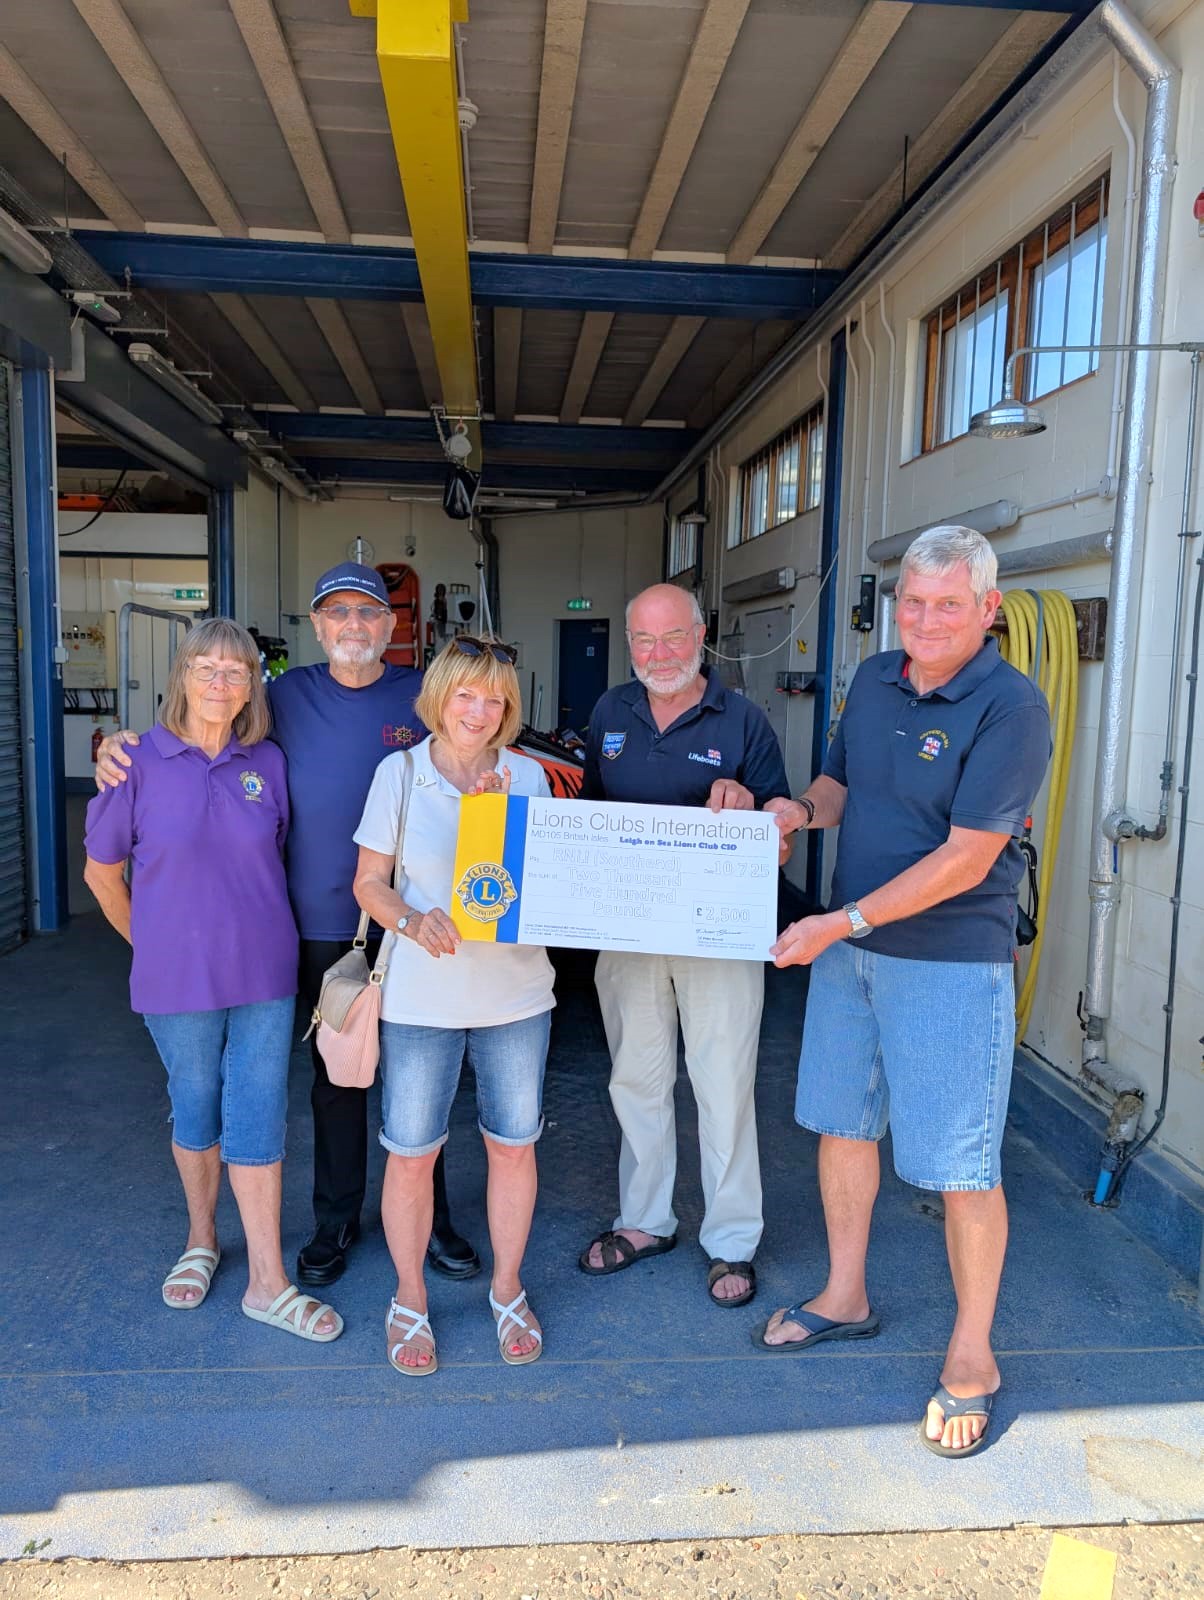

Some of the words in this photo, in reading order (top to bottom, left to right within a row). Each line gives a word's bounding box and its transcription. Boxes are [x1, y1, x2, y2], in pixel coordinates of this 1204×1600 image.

[688, 751, 721, 767] Lifeboats
[532, 808, 583, 829] Lions
[589, 811, 645, 834] Clubs
[652, 816, 769, 841] International
[531, 829, 562, 840] MD105
[563, 831, 589, 842] British
[591, 833, 609, 843] Isles
[619, 836, 643, 846] Leigh
[657, 839, 672, 847] Sea
[673, 840, 697, 849] Lions
[698, 841, 719, 850] Club
[720, 843, 738, 851] CIO
[472, 866, 506, 879] LIONS
[569, 867, 601, 881] Two
[603, 868, 682, 887] Thousand
[480, 880, 496, 901] L
[570, 882, 602, 899] Five
[606, 885, 677, 904] Hundred
